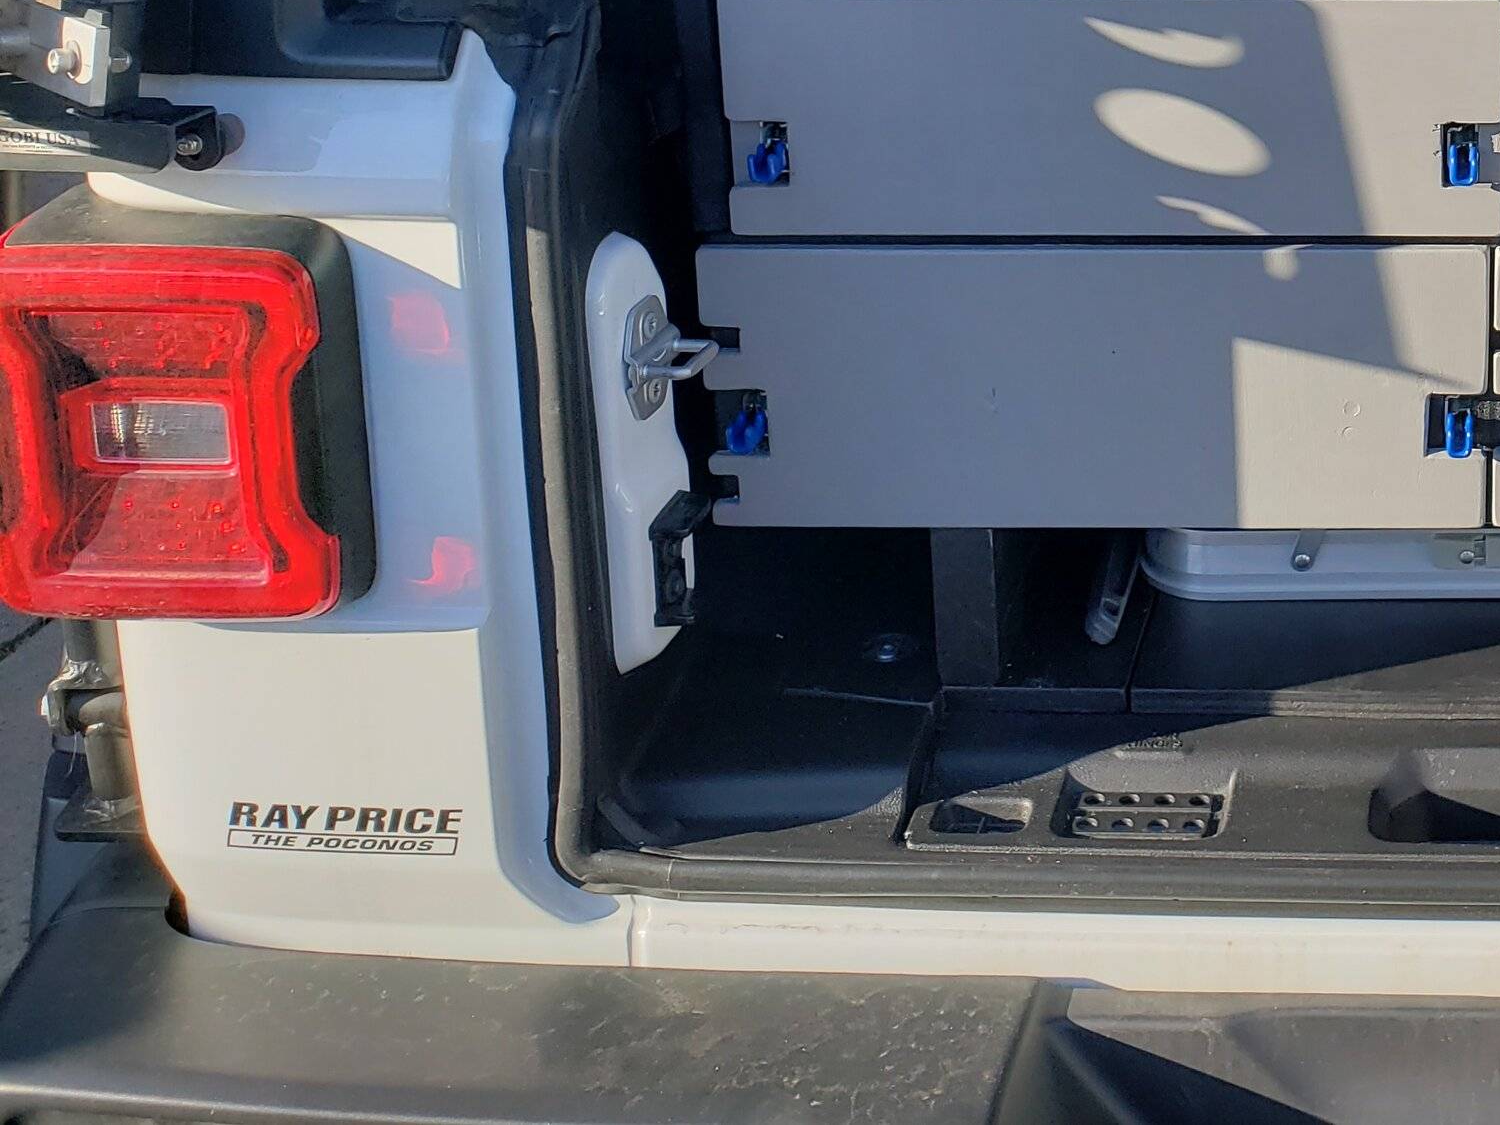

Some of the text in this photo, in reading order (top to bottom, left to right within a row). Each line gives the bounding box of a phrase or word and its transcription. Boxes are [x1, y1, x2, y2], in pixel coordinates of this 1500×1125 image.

[47, 132, 79, 146] USA
[228, 801, 464, 834] RAY PRICE
[251, 834, 434, 852] THE POCONOS
